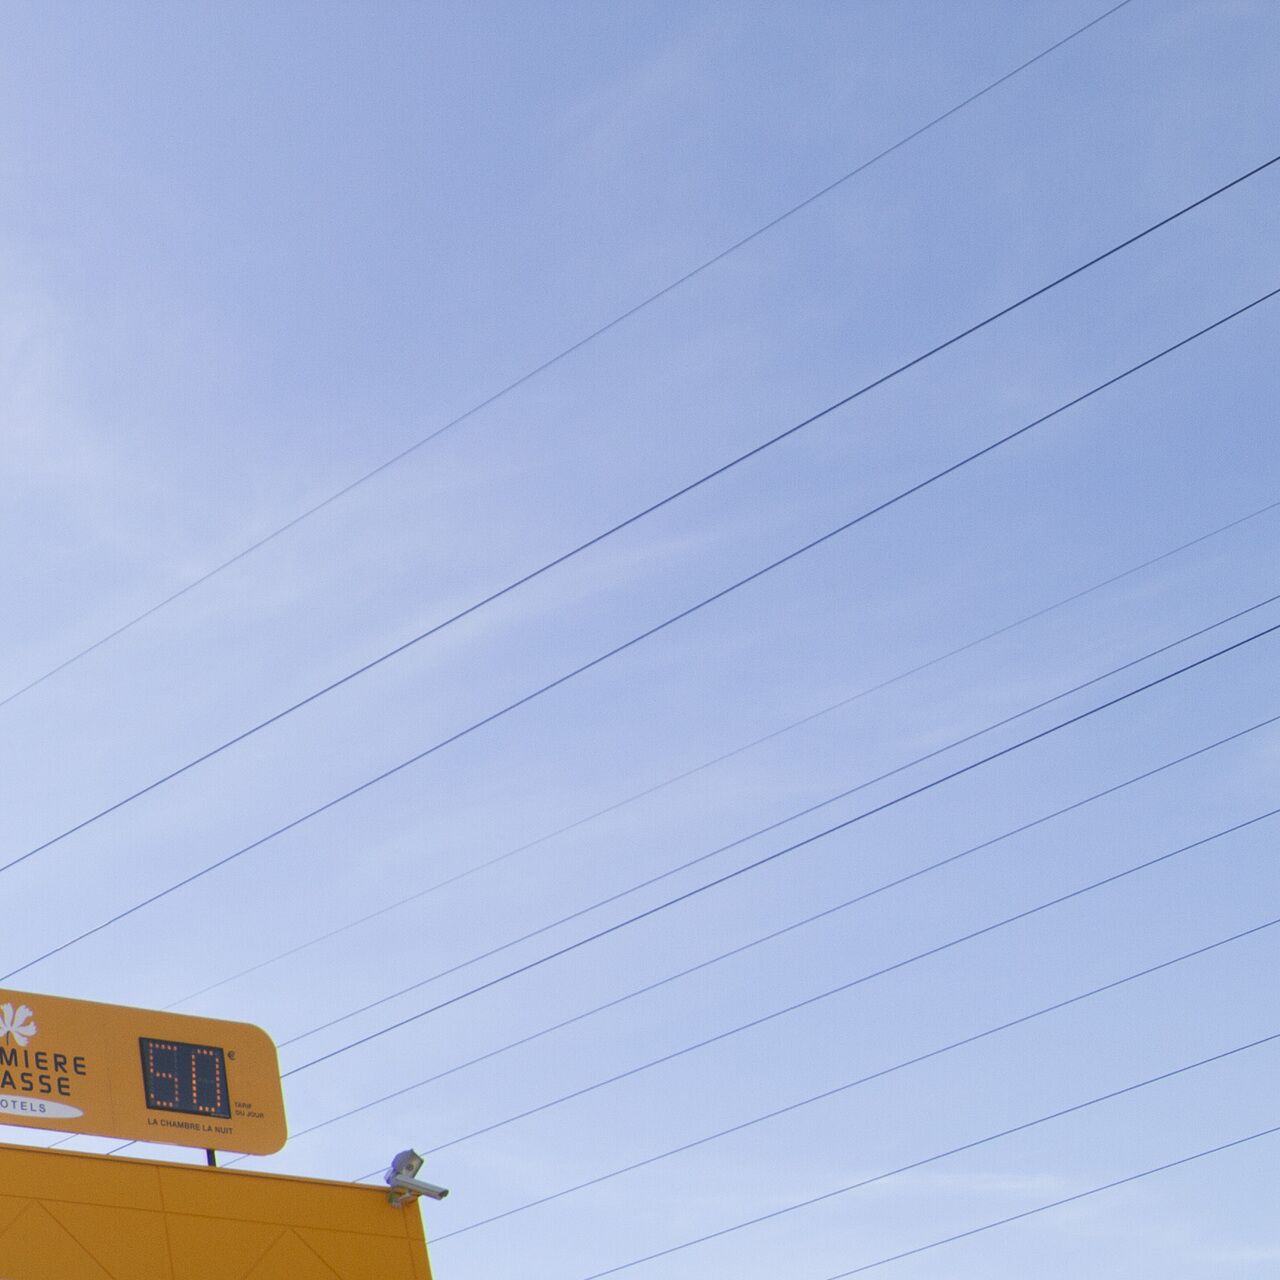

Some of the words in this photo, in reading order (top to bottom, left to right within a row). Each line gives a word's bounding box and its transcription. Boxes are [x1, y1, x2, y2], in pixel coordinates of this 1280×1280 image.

[149, 1042, 221, 1113] 50
[246, 1111, 264, 1119] JOUR
[148, 1118, 158, 1126] LA
[160, 1119, 200, 1131] CHAMBRE
[202, 1123, 213, 1132] LA
[215, 1125, 233, 1135] NUIT
